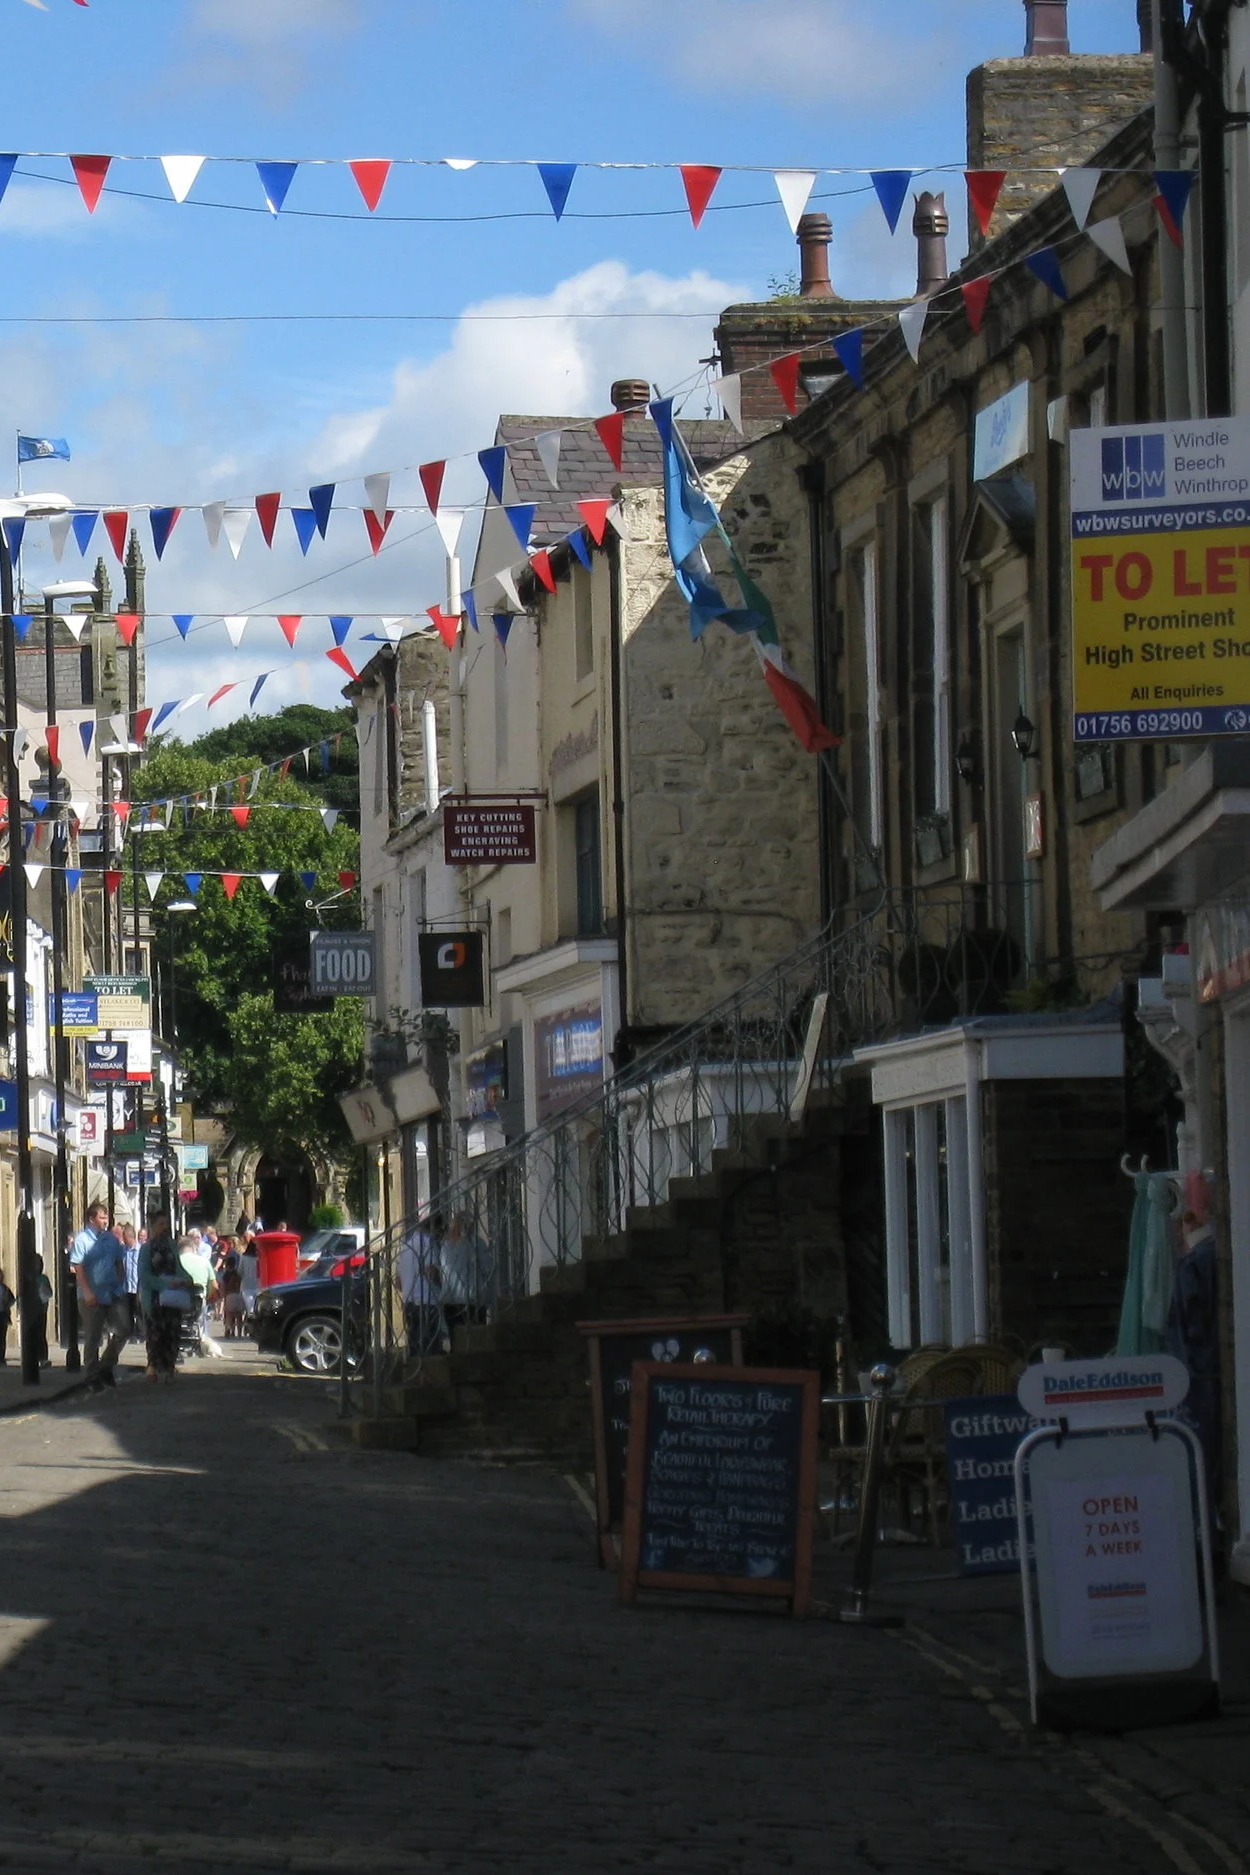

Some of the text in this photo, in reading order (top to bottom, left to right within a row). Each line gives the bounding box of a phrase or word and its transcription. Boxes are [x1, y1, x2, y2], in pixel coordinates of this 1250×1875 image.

[1174, 431, 1229, 449] Windle
[1174, 454, 1225, 472] Beech
[1102, 466, 1166, 490] wbw
[1174, 478, 1248, 495] Winthrop
[1080, 551, 1153, 602] TO
[1123, 608, 1235, 632] Prominent
[1085, 644, 1134, 669] High
[1141, 641, 1206, 663] Street
[1130, 683, 1224, 702] All Enquiries
[1077, 711, 1203, 736] 01756 692900
[456, 813, 523, 822] KEY CUTTING
[454, 824, 525, 834] SHOE REPAIRS
[462, 836, 519, 846] ENGRAVING
[450, 848, 530, 858] WATCH REPAIRS
[315, 949, 371, 982] FOOD
[94, 986, 134, 995] TO LET
[1043, 1371, 1164, 1393] DaleEddison
[1082, 1496, 1138, 1516] OPEN
[1084, 1520, 1141, 1537] 7 DAYS
[1085, 1541, 1143, 1557] A WEEK
